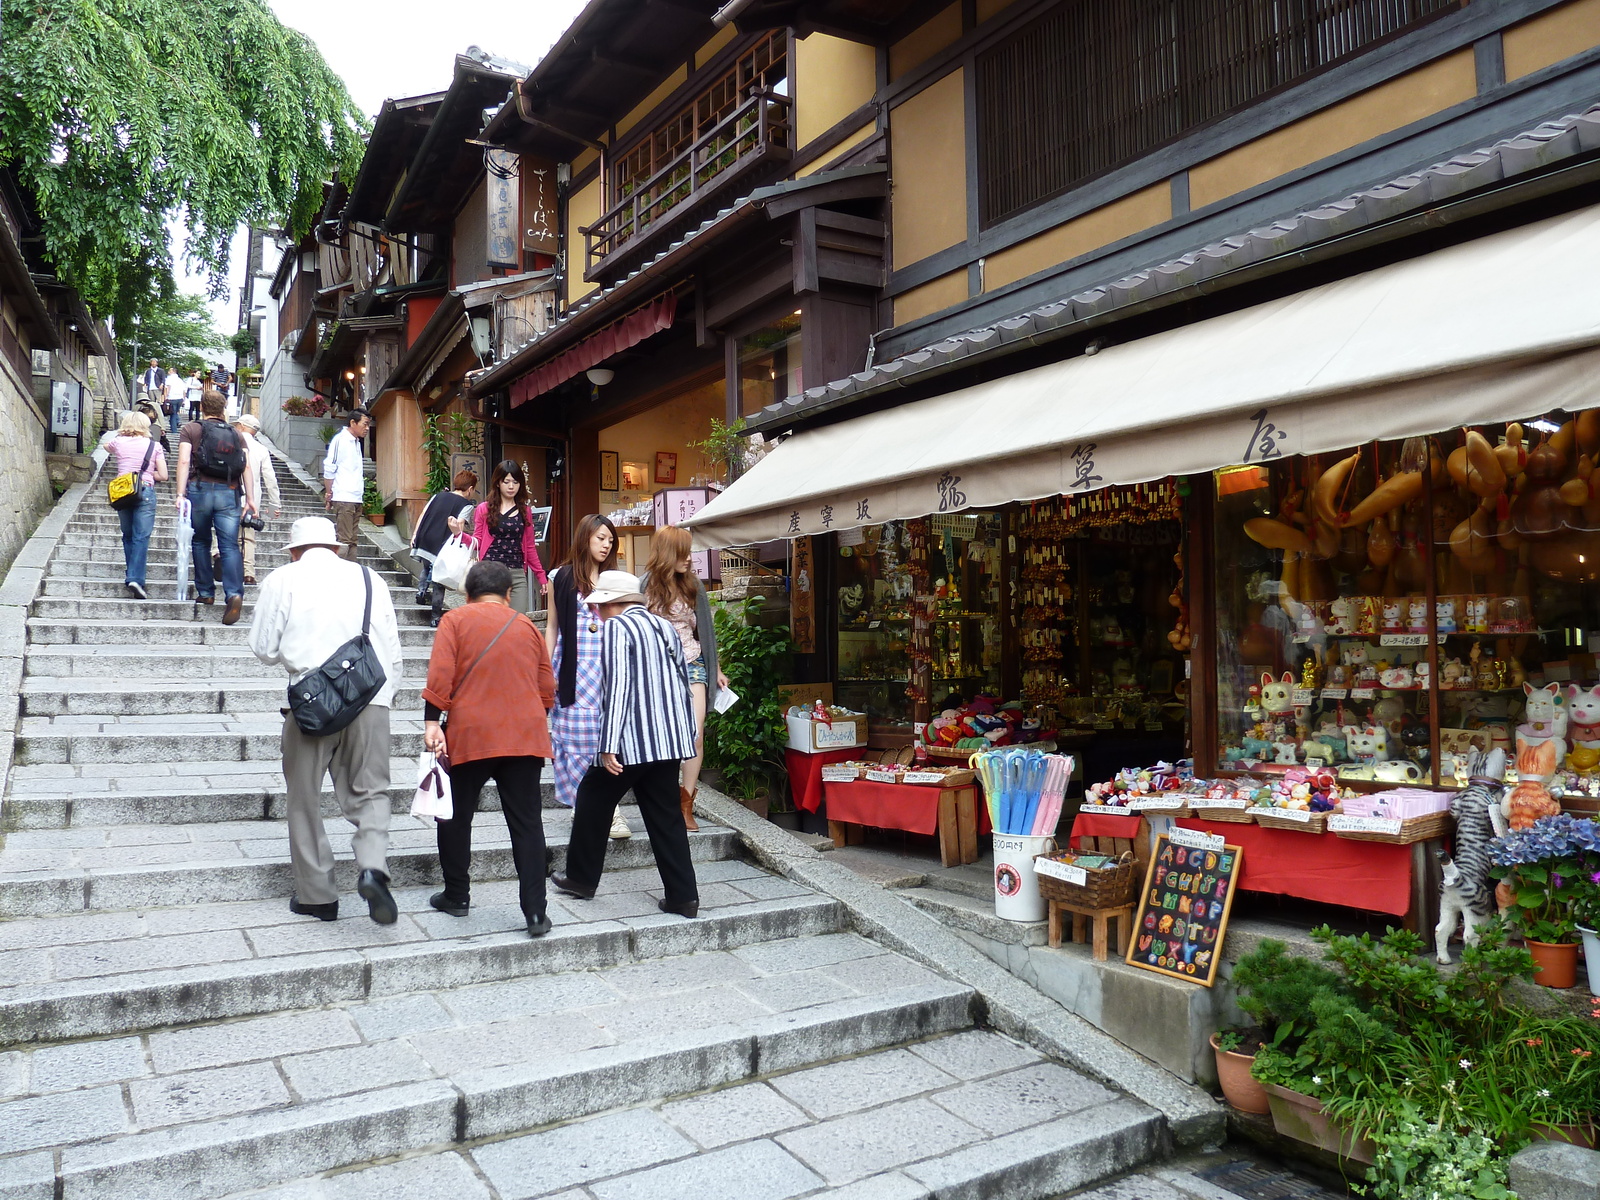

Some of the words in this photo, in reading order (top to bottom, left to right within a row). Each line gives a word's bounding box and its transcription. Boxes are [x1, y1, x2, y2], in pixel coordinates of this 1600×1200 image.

[527, 228, 554, 241] cafe
[1160, 845, 1173, 864] A
[1176, 846, 1187, 865] B
[1189, 849, 1204, 867] C
[1205, 851, 1216, 870] D
[1219, 855, 1232, 872] E
[1155, 865, 1167, 885] F
[1166, 872, 1178, 888] G
[1179, 873, 1192, 891] H
[1200, 875, 1216, 894] J
[1216, 879, 1227, 898] K
[1149, 889, 1161, 906] L
[1163, 892, 1178, 909] M
[1194, 899, 1206, 917] O
[1209, 901, 1222, 920] P
[1173, 918, 1186, 936] S
[1188, 922, 1203, 940] T
[1203, 927, 1217, 944] U
[1139, 935, 1152, 951] V
[1151, 939, 1166, 955] W
[1167, 941, 1182, 959] X
[1183, 942, 1197, 963] Y
